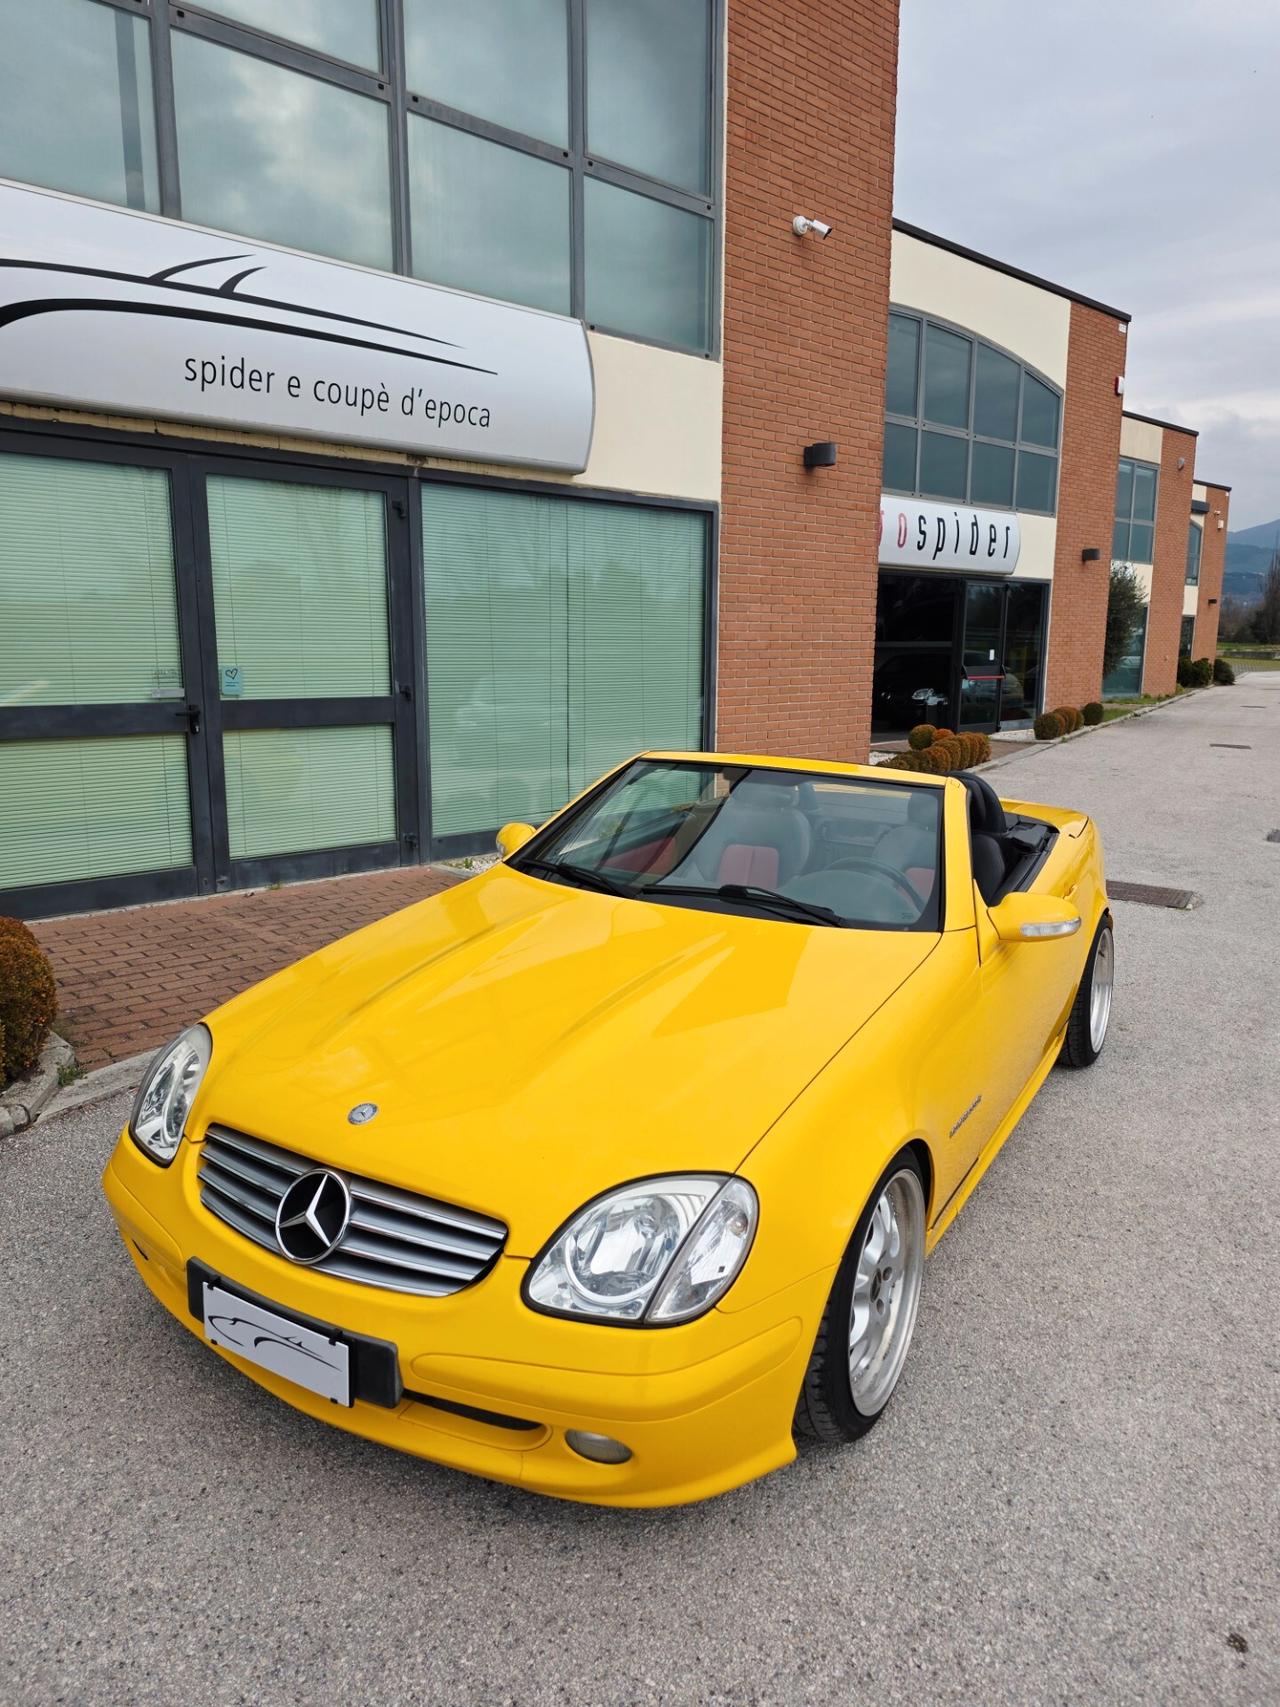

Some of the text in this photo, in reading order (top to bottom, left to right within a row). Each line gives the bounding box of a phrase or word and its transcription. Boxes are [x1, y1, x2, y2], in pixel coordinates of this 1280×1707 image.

[184, 355, 275, 393] spider
[287, 375, 301, 398] e
[313, 380, 390, 416] coupè
